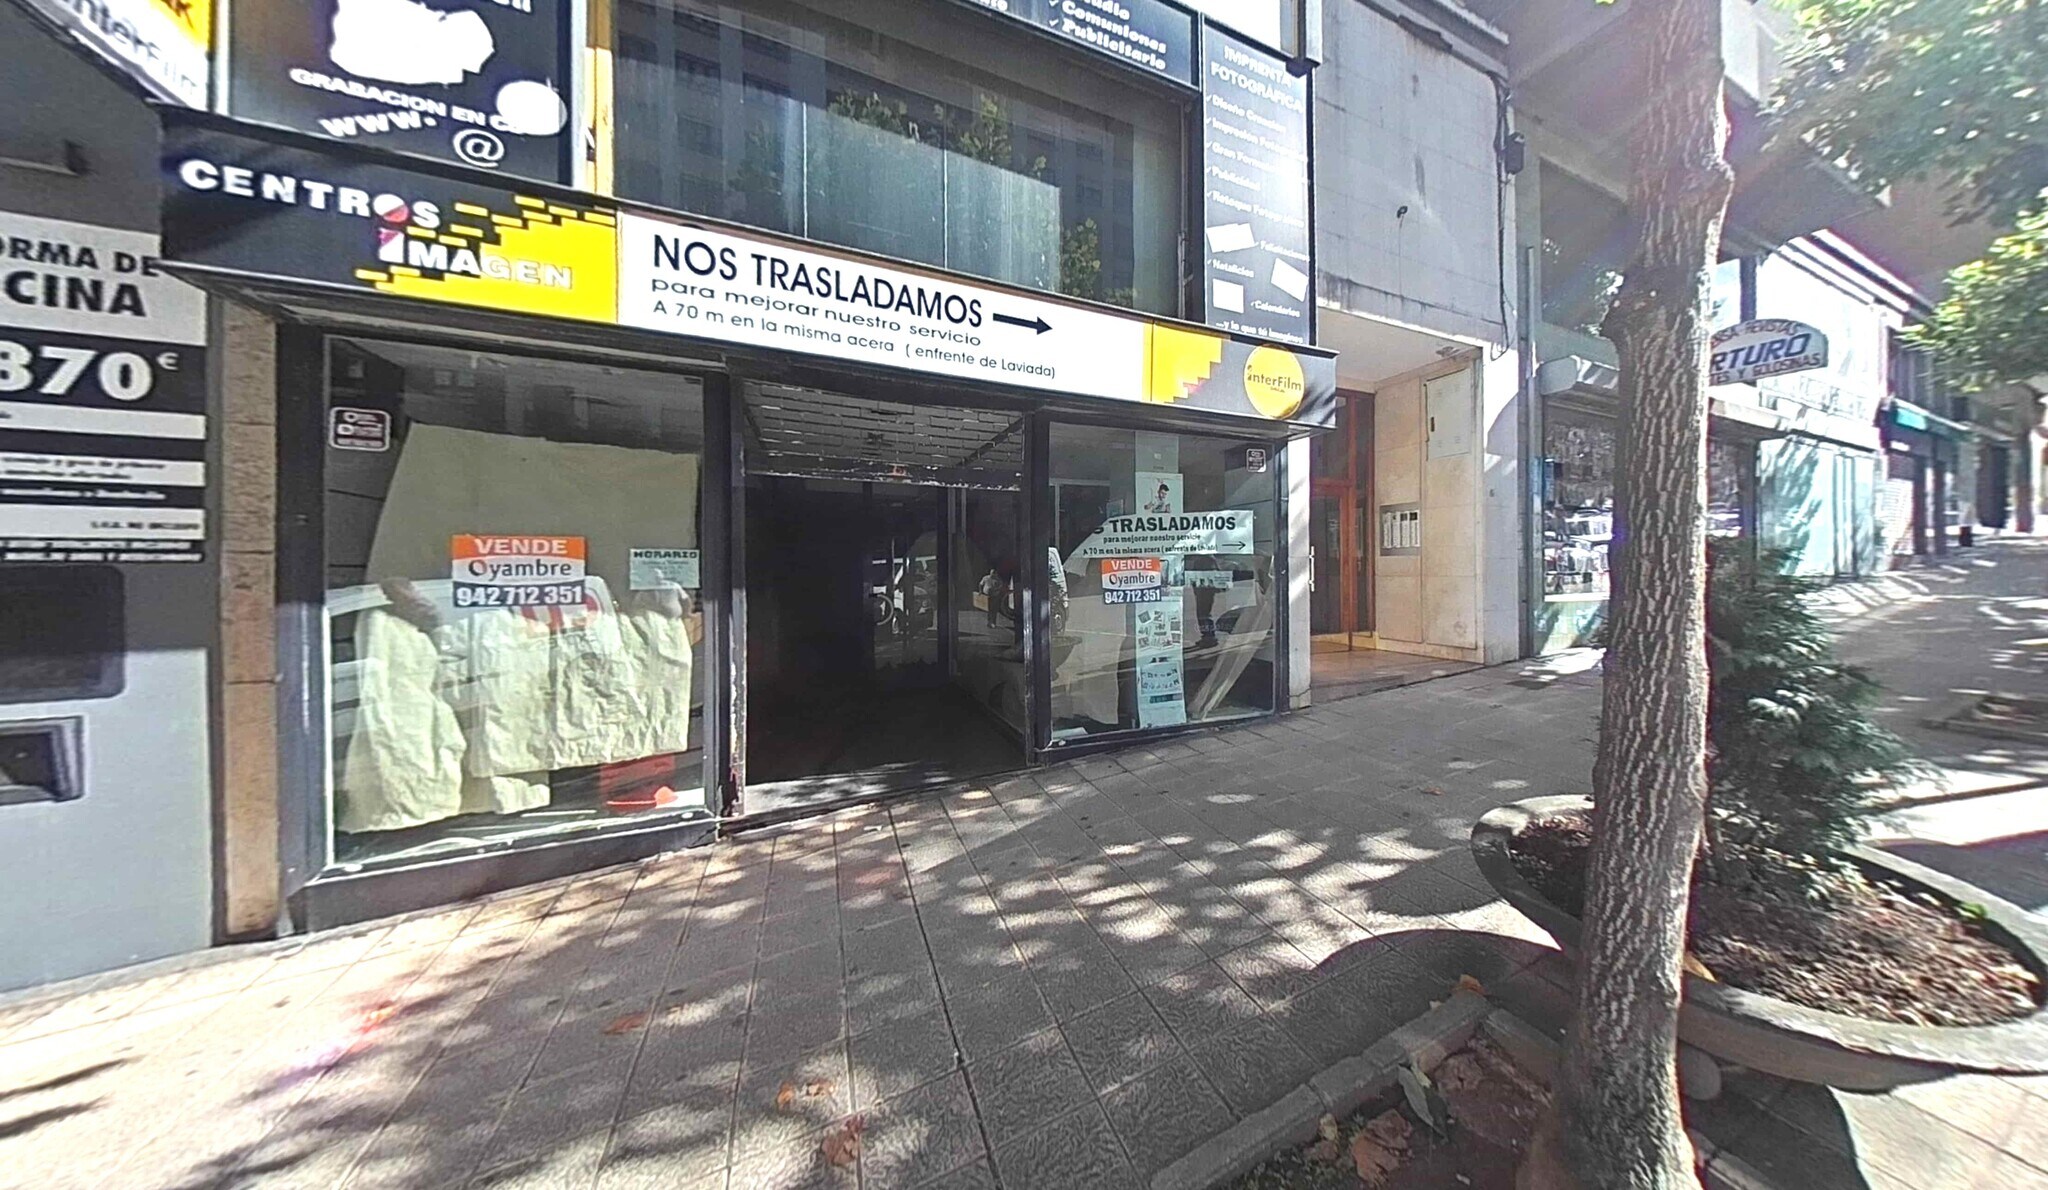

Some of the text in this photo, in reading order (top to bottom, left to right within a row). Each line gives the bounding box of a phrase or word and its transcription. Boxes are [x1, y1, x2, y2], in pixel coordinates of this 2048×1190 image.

[289, 68, 446, 117] GRABACION
[452, 105, 486, 127] EN
[180, 160, 440, 229] CENTROS
[0, 237, 99, 270] RMA
[378, 228, 573, 290] IMAGEN
[654, 234, 982, 328] NOS TRASLADAMOS
[651, 278, 981, 347] para mejorar nuestro servicio
[653, 300, 668, 315] A
[675, 303, 699, 319] 70
[706, 311, 724, 324] m
[731, 315, 754, 328] en
[761, 318, 777, 332] la
[784, 323, 842, 344] misma
[847, 335, 895, 352] acera
[979, 355, 998, 369] de
[1001, 359, 1056, 380] Laviada)
[1711, 333, 1812, 372] RTURO
[1109, 516, 1236, 533] TRASLADAMOS
[474, 539, 569, 555] VENDE
[1103, 536, 1120, 544] para
[1121, 535, 1148, 544] mejorar
[633, 551, 698, 559] HORARIO
[1111, 559, 1152, 570] VENDE
[468, 559, 573, 581] Oyambre
[1109, 574, 1155, 587] Oyambre
[456, 586, 582, 606] 942 712 351
[1105, 589, 1160, 604] 942 712 351
